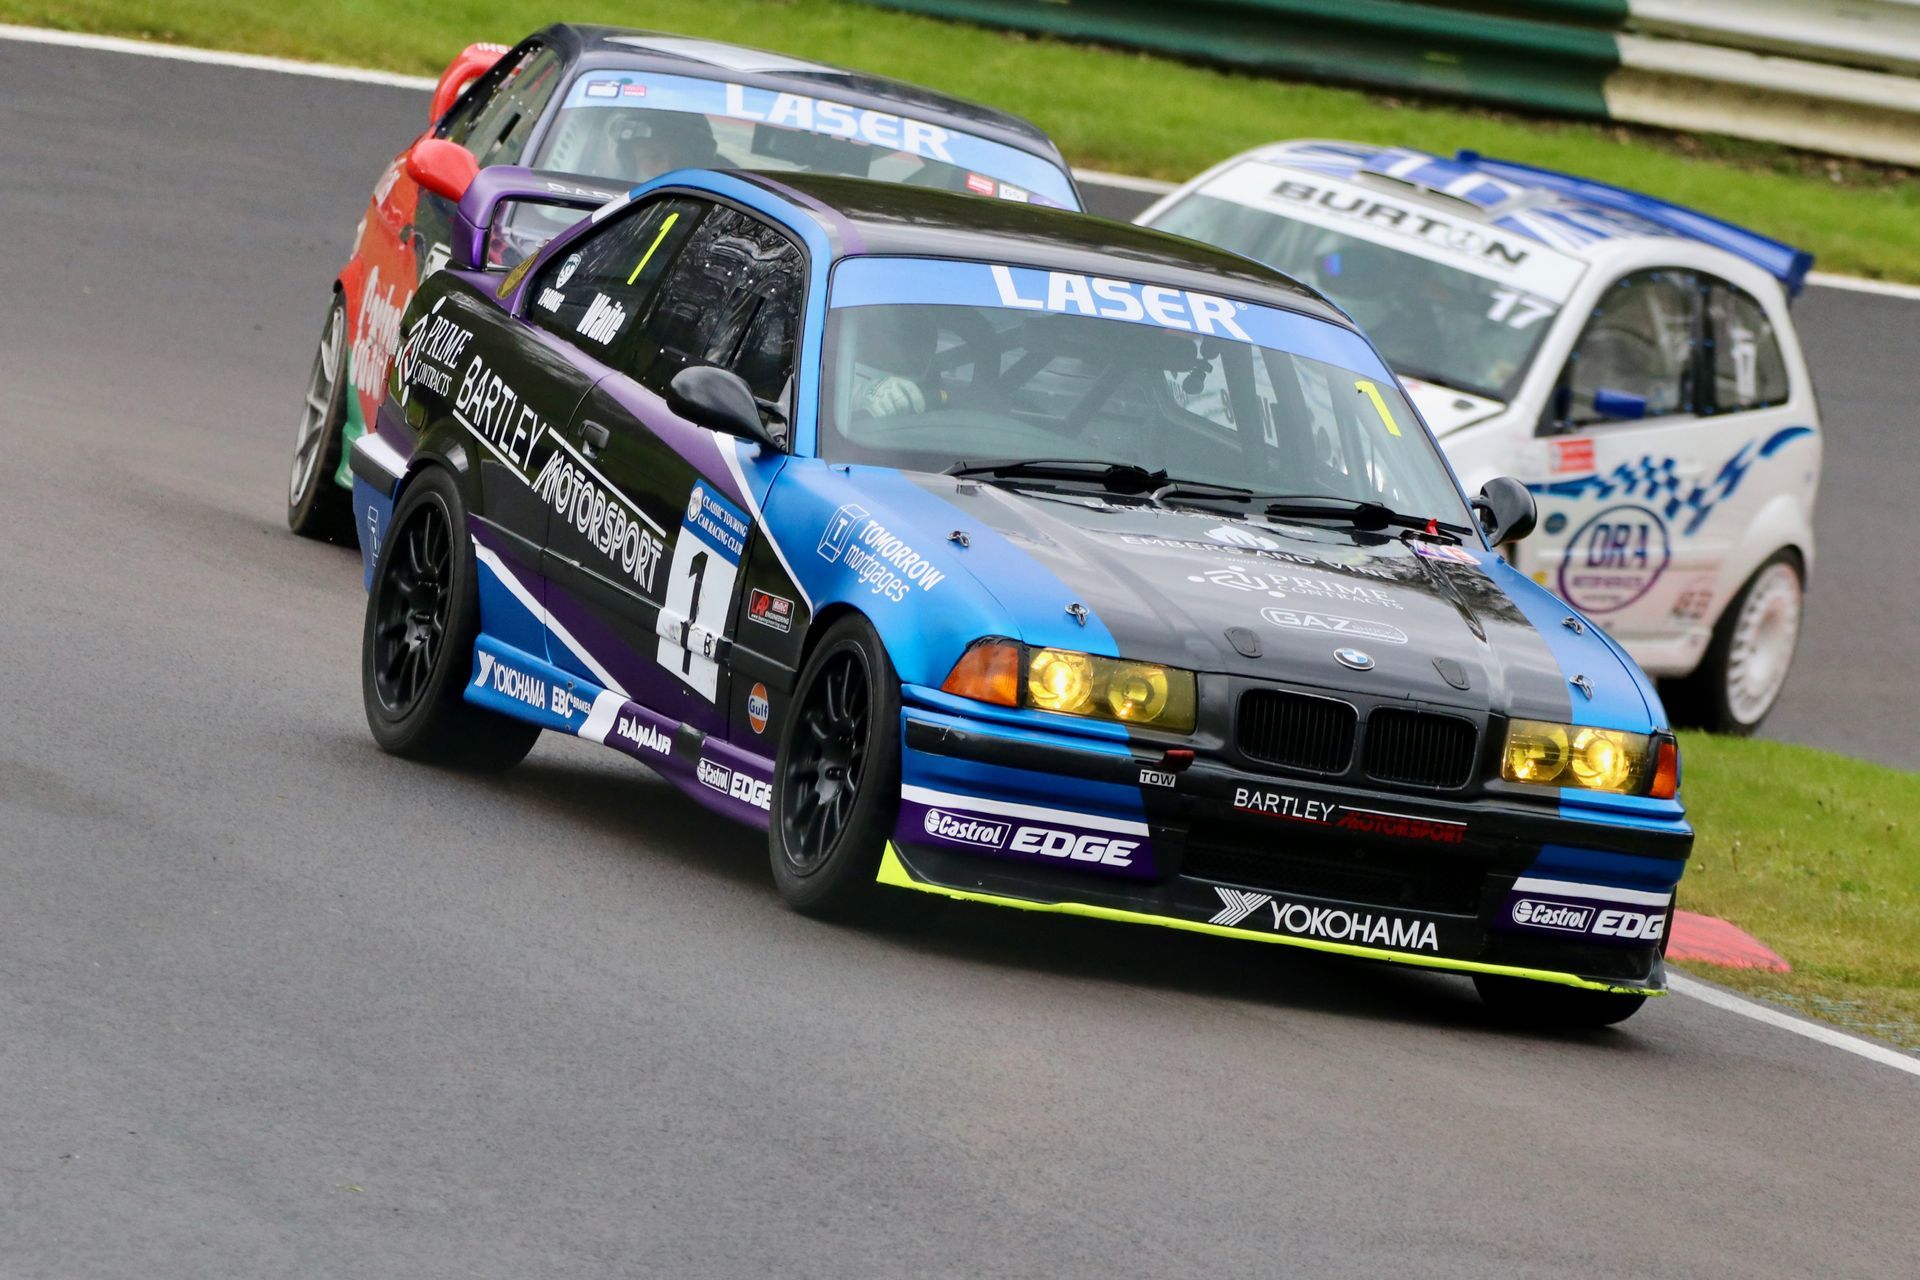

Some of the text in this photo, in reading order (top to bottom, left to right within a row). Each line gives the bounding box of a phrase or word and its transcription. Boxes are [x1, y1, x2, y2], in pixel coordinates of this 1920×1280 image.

[725, 83, 954, 163] LASER
[1272, 180, 1530, 266] BURTON
[627, 212, 679, 285] 1
[990, 265, 1253, 342] LASER
[1485, 290, 1554, 329] 17
[422, 314, 474, 370] PRIME
[413, 360, 453, 397] CONTRACTS
[1354, 380, 1402, 437] 1
[456, 355, 664, 594] BARTLEY MOTORSPORT
[697, 513, 743, 556] CAR RACING CLUB
[703, 495, 748, 538] CLASSIC TOURING
[843, 544, 910, 602] mortgages
[858, 520, 945, 592] TOMORROW
[1120, 536, 1244, 555] EMBERS
[1256, 549, 1316, 565] AND
[1266, 573, 1397, 602] PRIME
[1276, 585, 1405, 611] CONTRACTS
[680, 550, 709, 677] 1
[1269, 610, 1351, 631] GAZ
[493, 661, 546, 709] YOKOHAMA
[551, 685, 592, 718] EBC BRAKES
[748, 701, 769, 722] Gulf
[617, 715, 672, 756] RAMAIR
[704, 764, 773, 810] Castrol EDGE
[1141, 772, 1174, 786] TOW
[1234, 788, 1468, 844] BARTLEY MOTORSPORT
[938, 817, 1140, 867] Castrol EDGE
[1270, 900, 1439, 951] YOKOHAMA
[1531, 904, 1589, 929] Castrol
